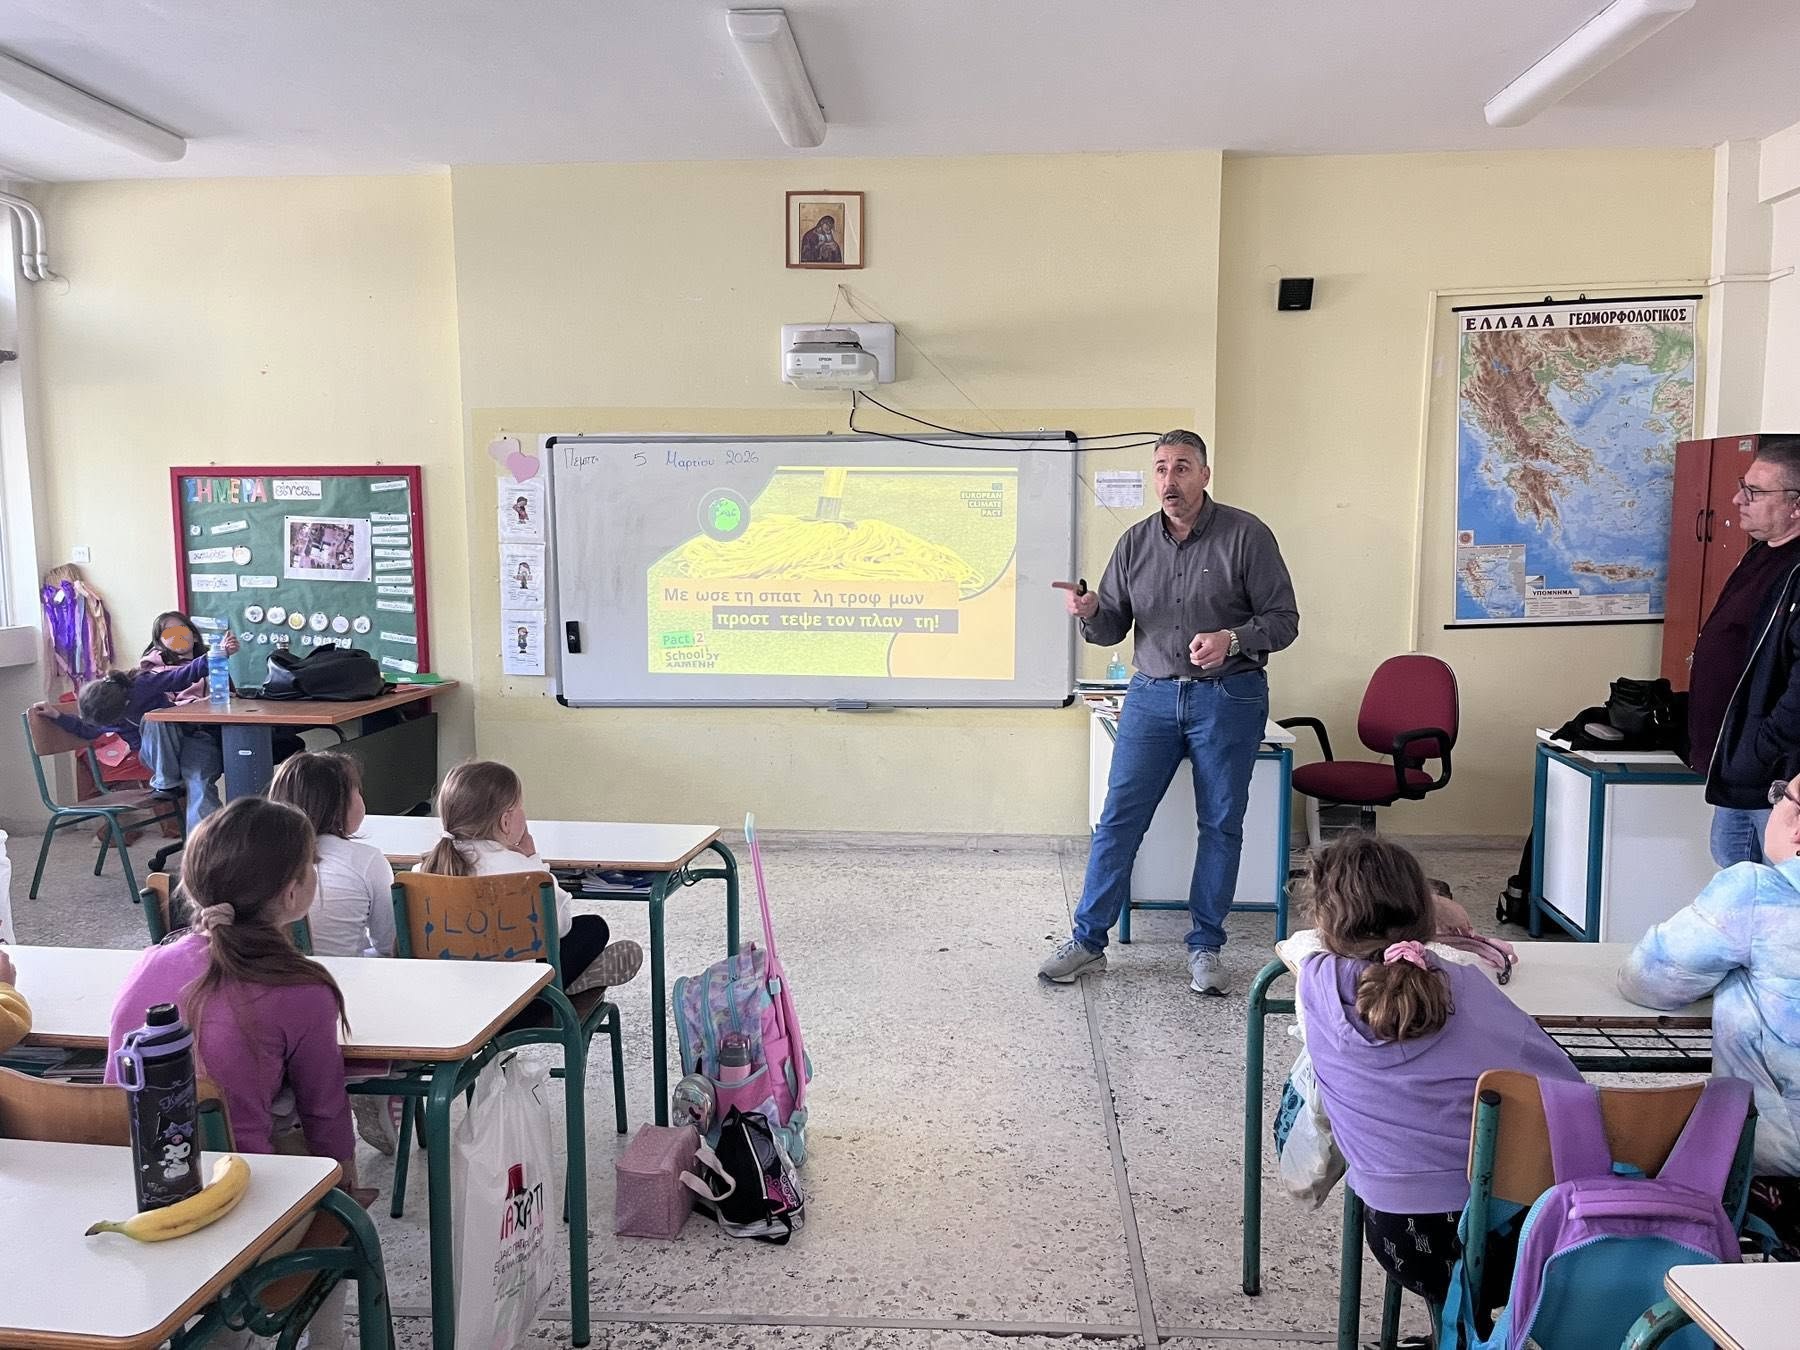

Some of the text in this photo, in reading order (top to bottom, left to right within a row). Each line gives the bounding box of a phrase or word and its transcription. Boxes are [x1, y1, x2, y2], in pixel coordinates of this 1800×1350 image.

[1465, 308, 1687, 330] ΕΛΛΑΔΑ ΓΕΩΜΟΡΦΟΛΟΓΙΚΟΣ
[633, 451, 648, 466] 5
[726, 450, 760, 465] 2026
[185, 478, 268, 503] ΣΗΜΕΡΑ
[981, 509, 1002, 517] PACT
[735, 591, 754, 606] τη
[826, 614, 855, 627] τον
[665, 648, 704, 662] School
[444, 909, 517, 935] LOL
